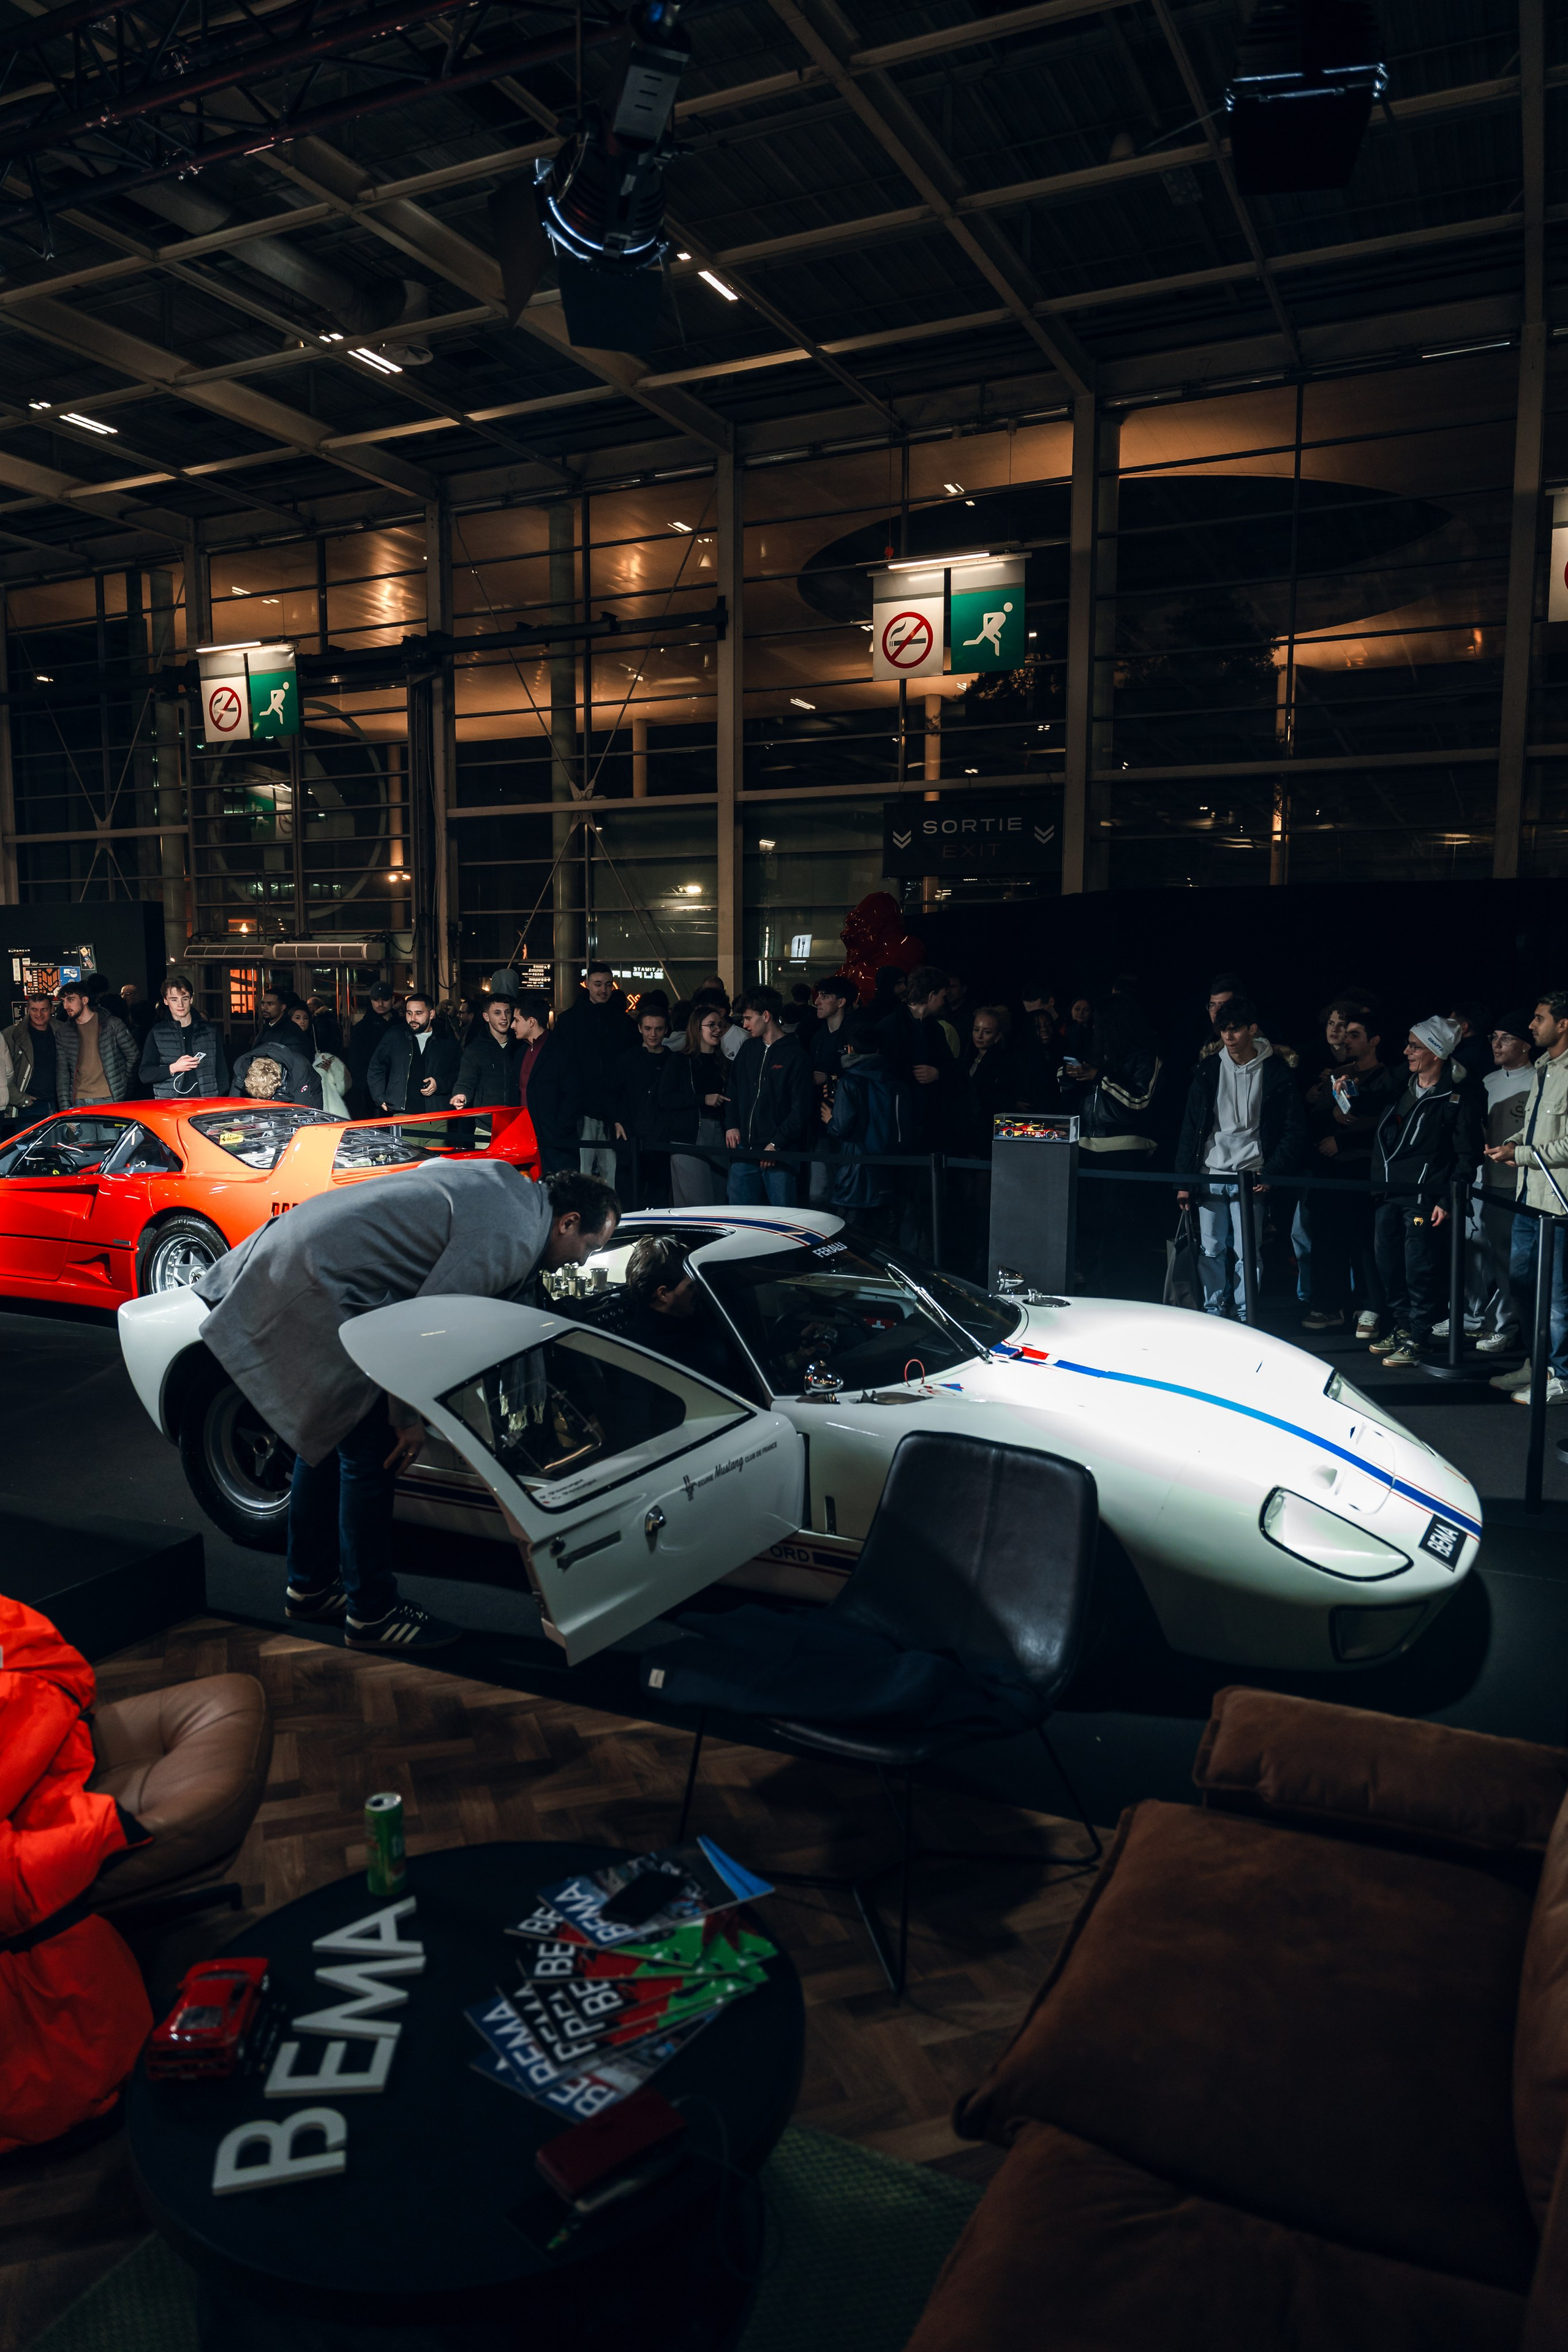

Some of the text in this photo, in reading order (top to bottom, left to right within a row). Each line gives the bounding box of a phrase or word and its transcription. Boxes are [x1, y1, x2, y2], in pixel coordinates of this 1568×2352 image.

[922, 817, 1022, 834] SORTIE
[943, 843, 1002, 858] EXIT
[812, 1242, 848, 1258] FERALU
[714, 1457, 744, 1479] Mustang
[745, 1452, 755, 1463] CLUB
[756, 1449, 761, 1458] DE
[762, 1441, 777, 1454] FRANCE
[770, 1545, 810, 1562] ORD
[1427, 1523, 1459, 1558] BEMA
[516, 1906, 564, 1935] BE
[554, 1881, 636, 1942] BEMA
[533, 1942, 576, 1977] BE
[568, 1980, 625, 2017] BE
[212, 1896, 426, 2196] BEMA
